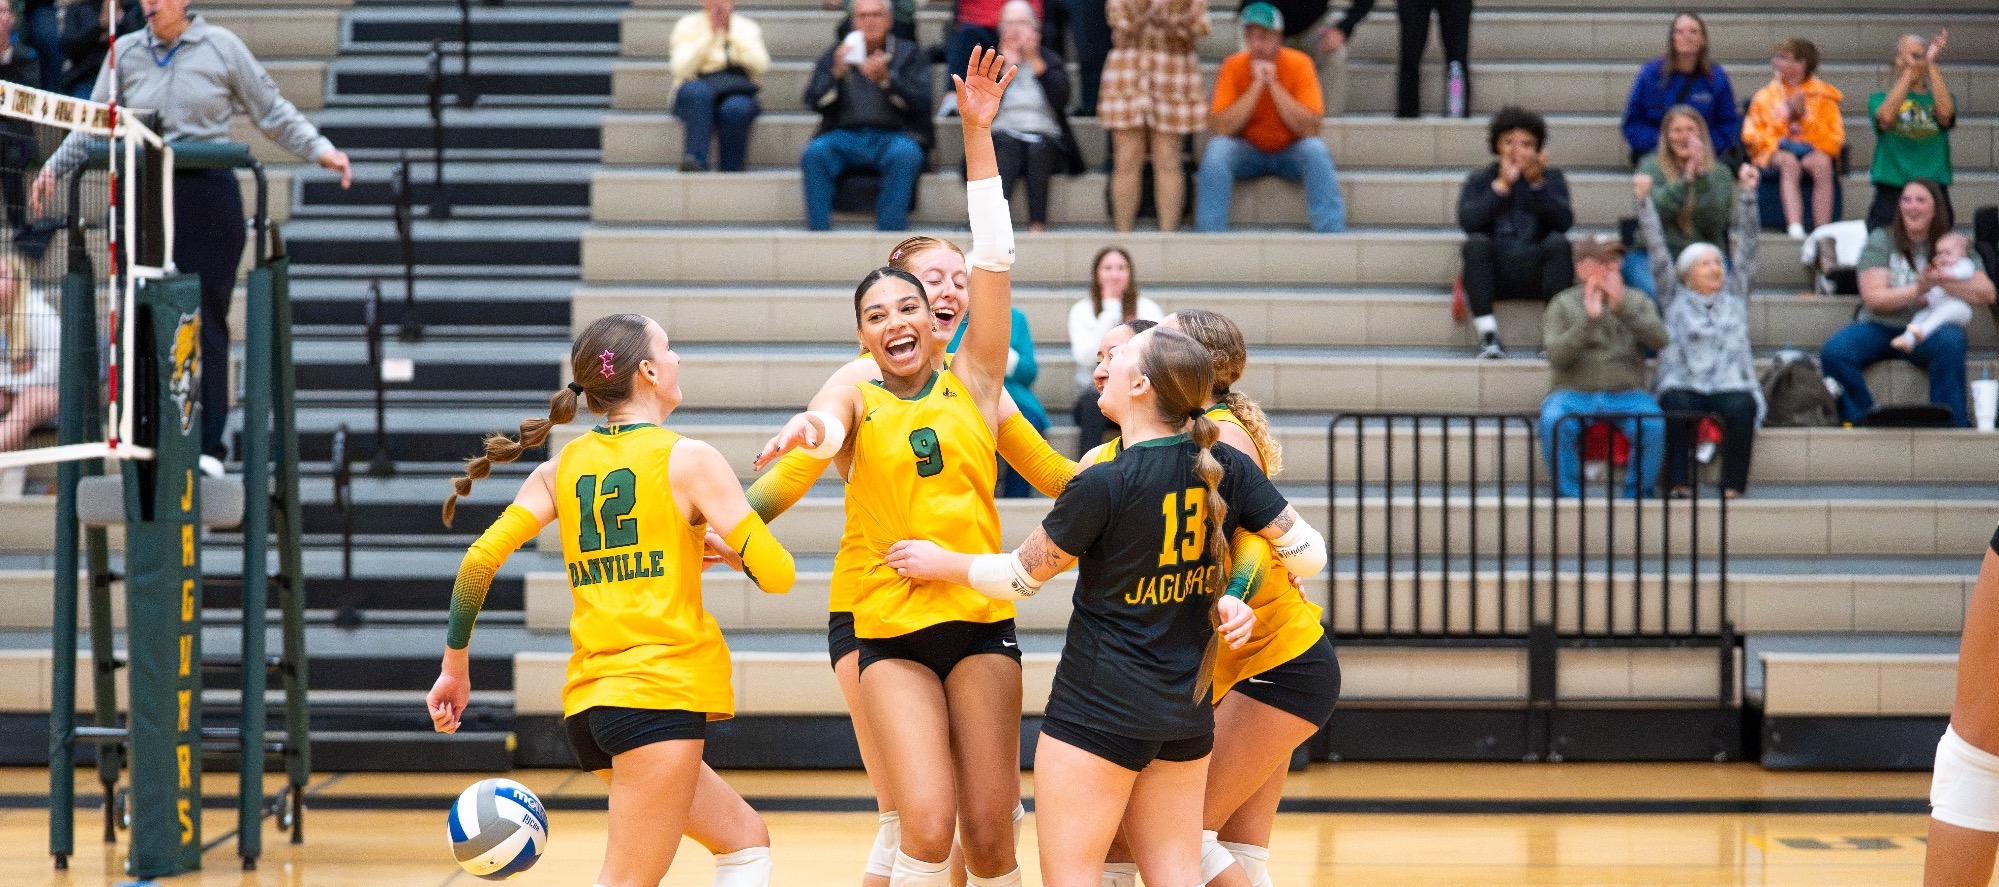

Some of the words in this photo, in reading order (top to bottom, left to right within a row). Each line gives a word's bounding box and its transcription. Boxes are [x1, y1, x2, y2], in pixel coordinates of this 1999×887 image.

[908, 426, 944, 478] 9
[575, 467, 638, 553] 12
[1158, 486, 1209, 568] 13
[568, 550, 665, 588] DANVILLE
